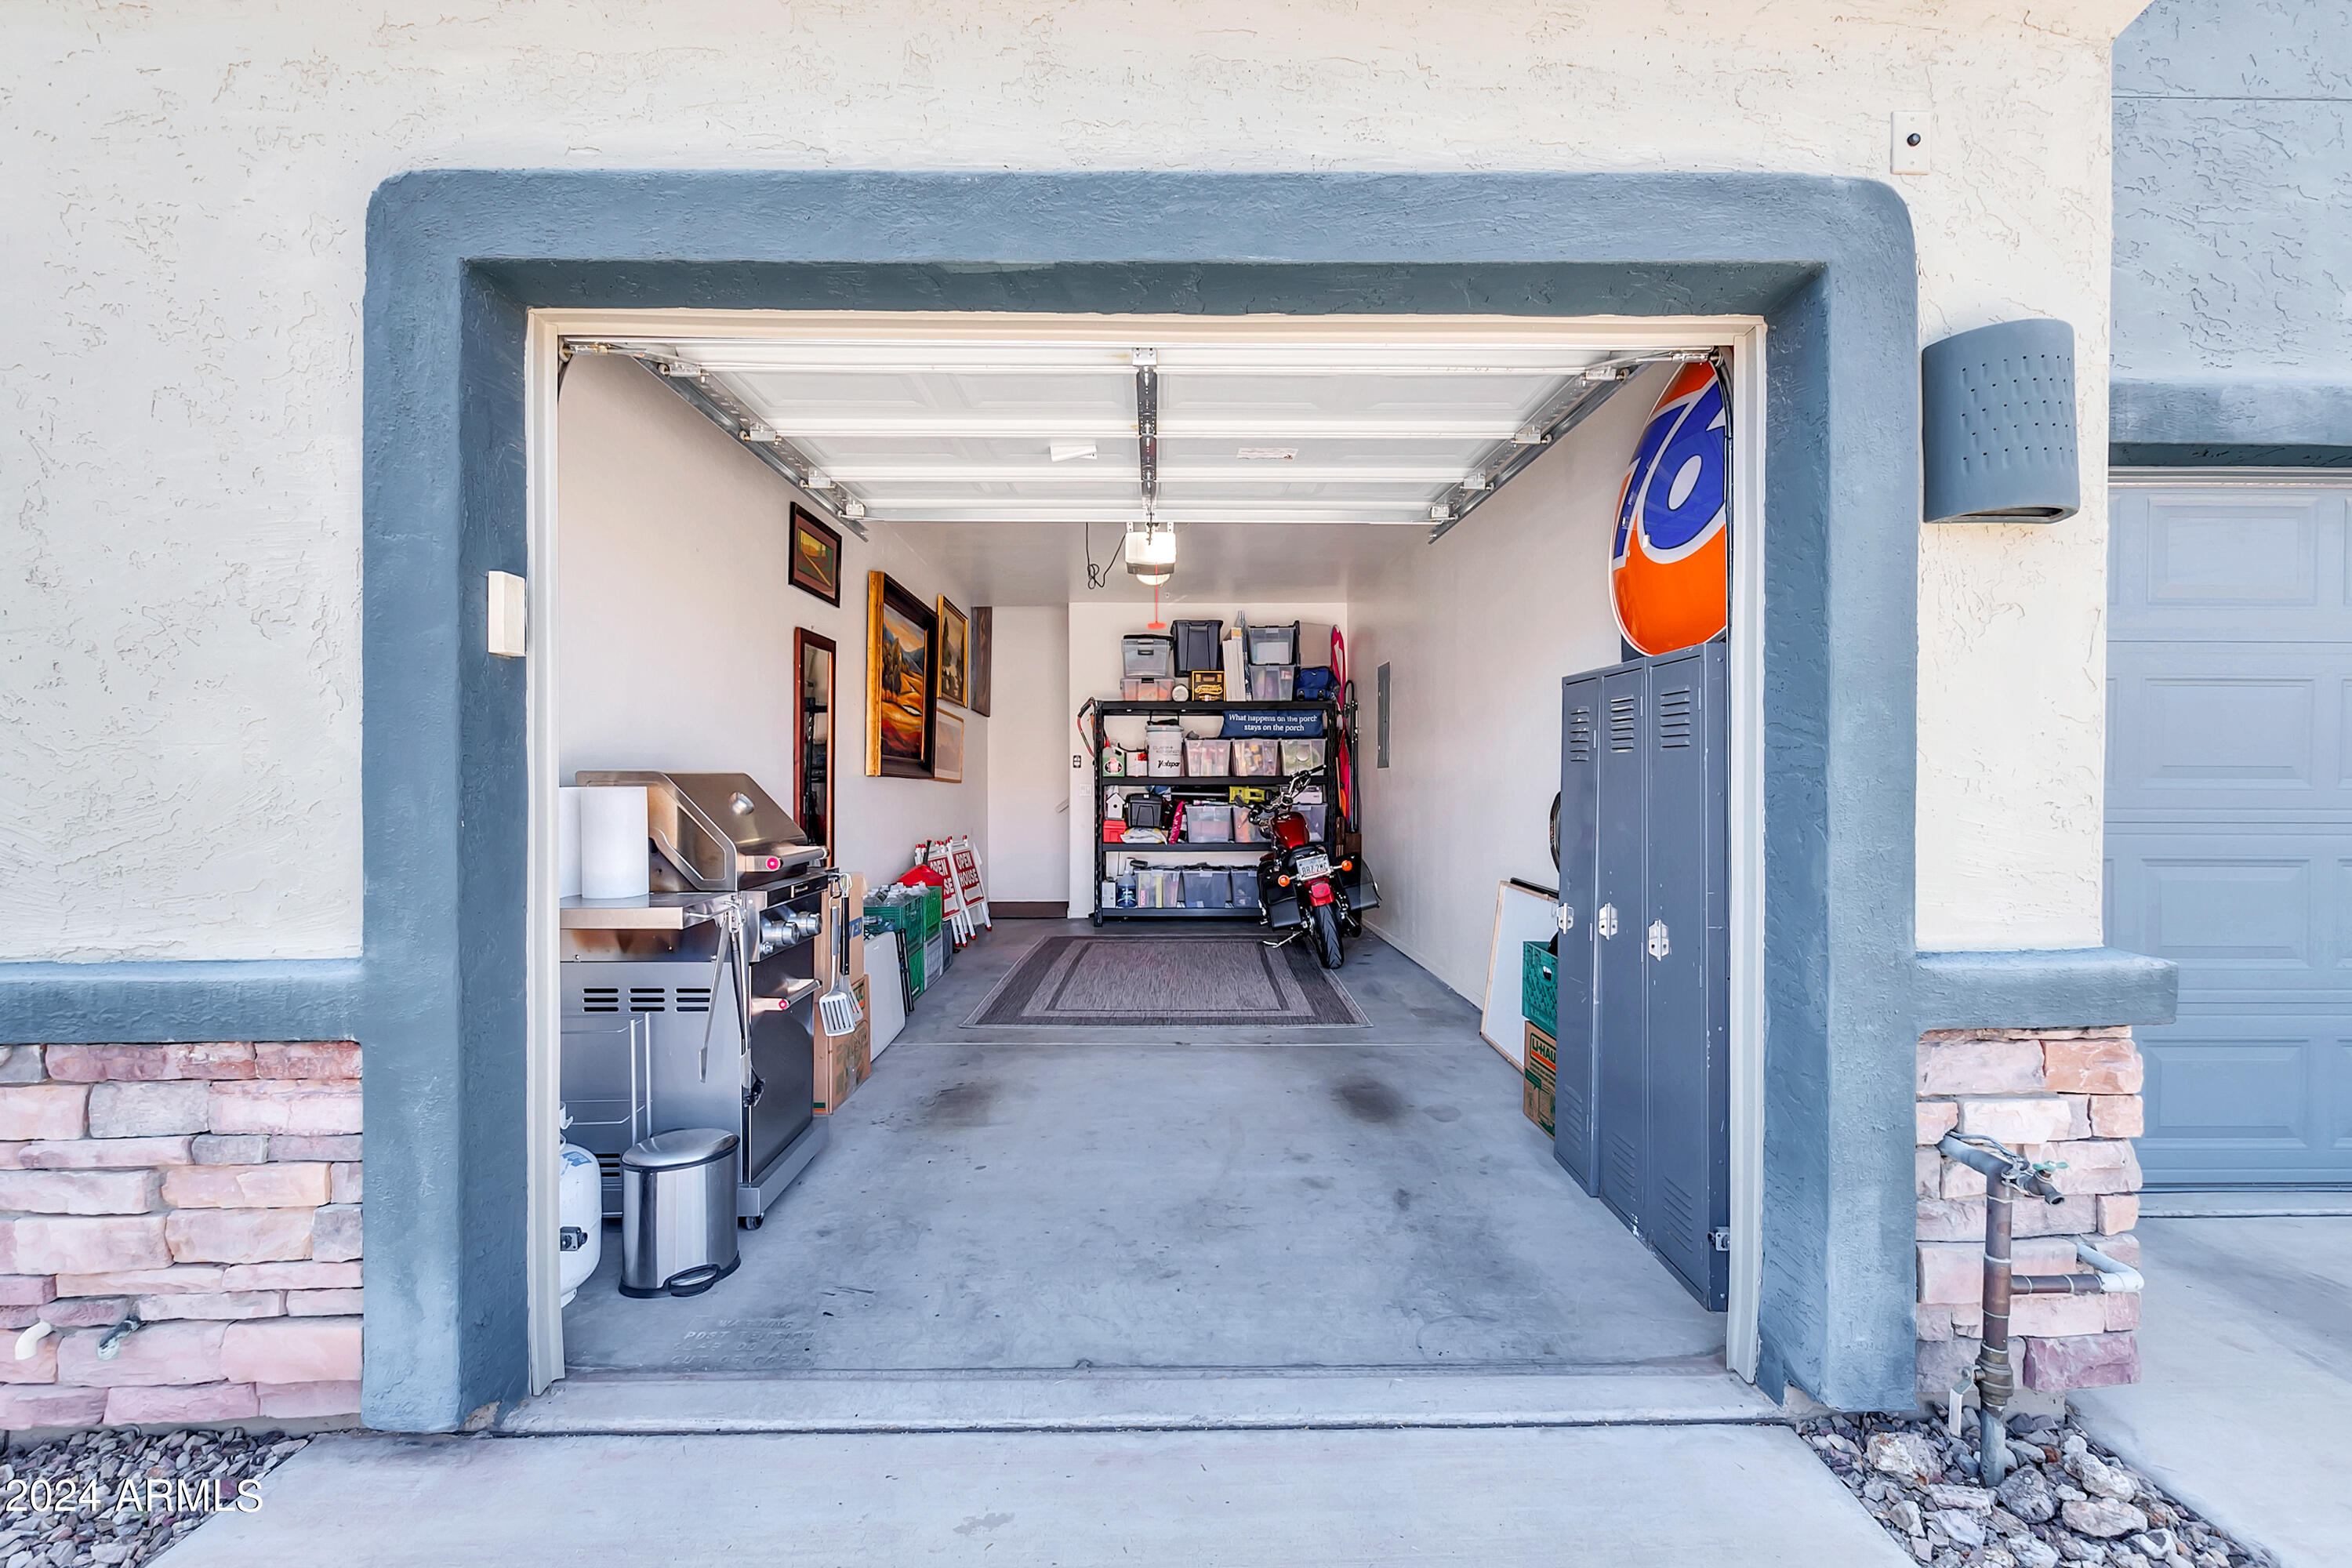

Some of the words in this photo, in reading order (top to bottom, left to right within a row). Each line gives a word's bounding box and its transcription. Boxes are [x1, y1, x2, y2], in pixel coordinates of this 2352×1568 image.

[1613, 379, 1726, 560] 76
[1247, 714, 1276, 724] happens
[1285, 724, 1305, 733] porch
[956, 851, 973, 870] OPEN
[958, 868, 979, 887] HOUSE
[1532, 1037, 1556, 1064] U-HAU
[671, 1355, 709, 1364] CUT
